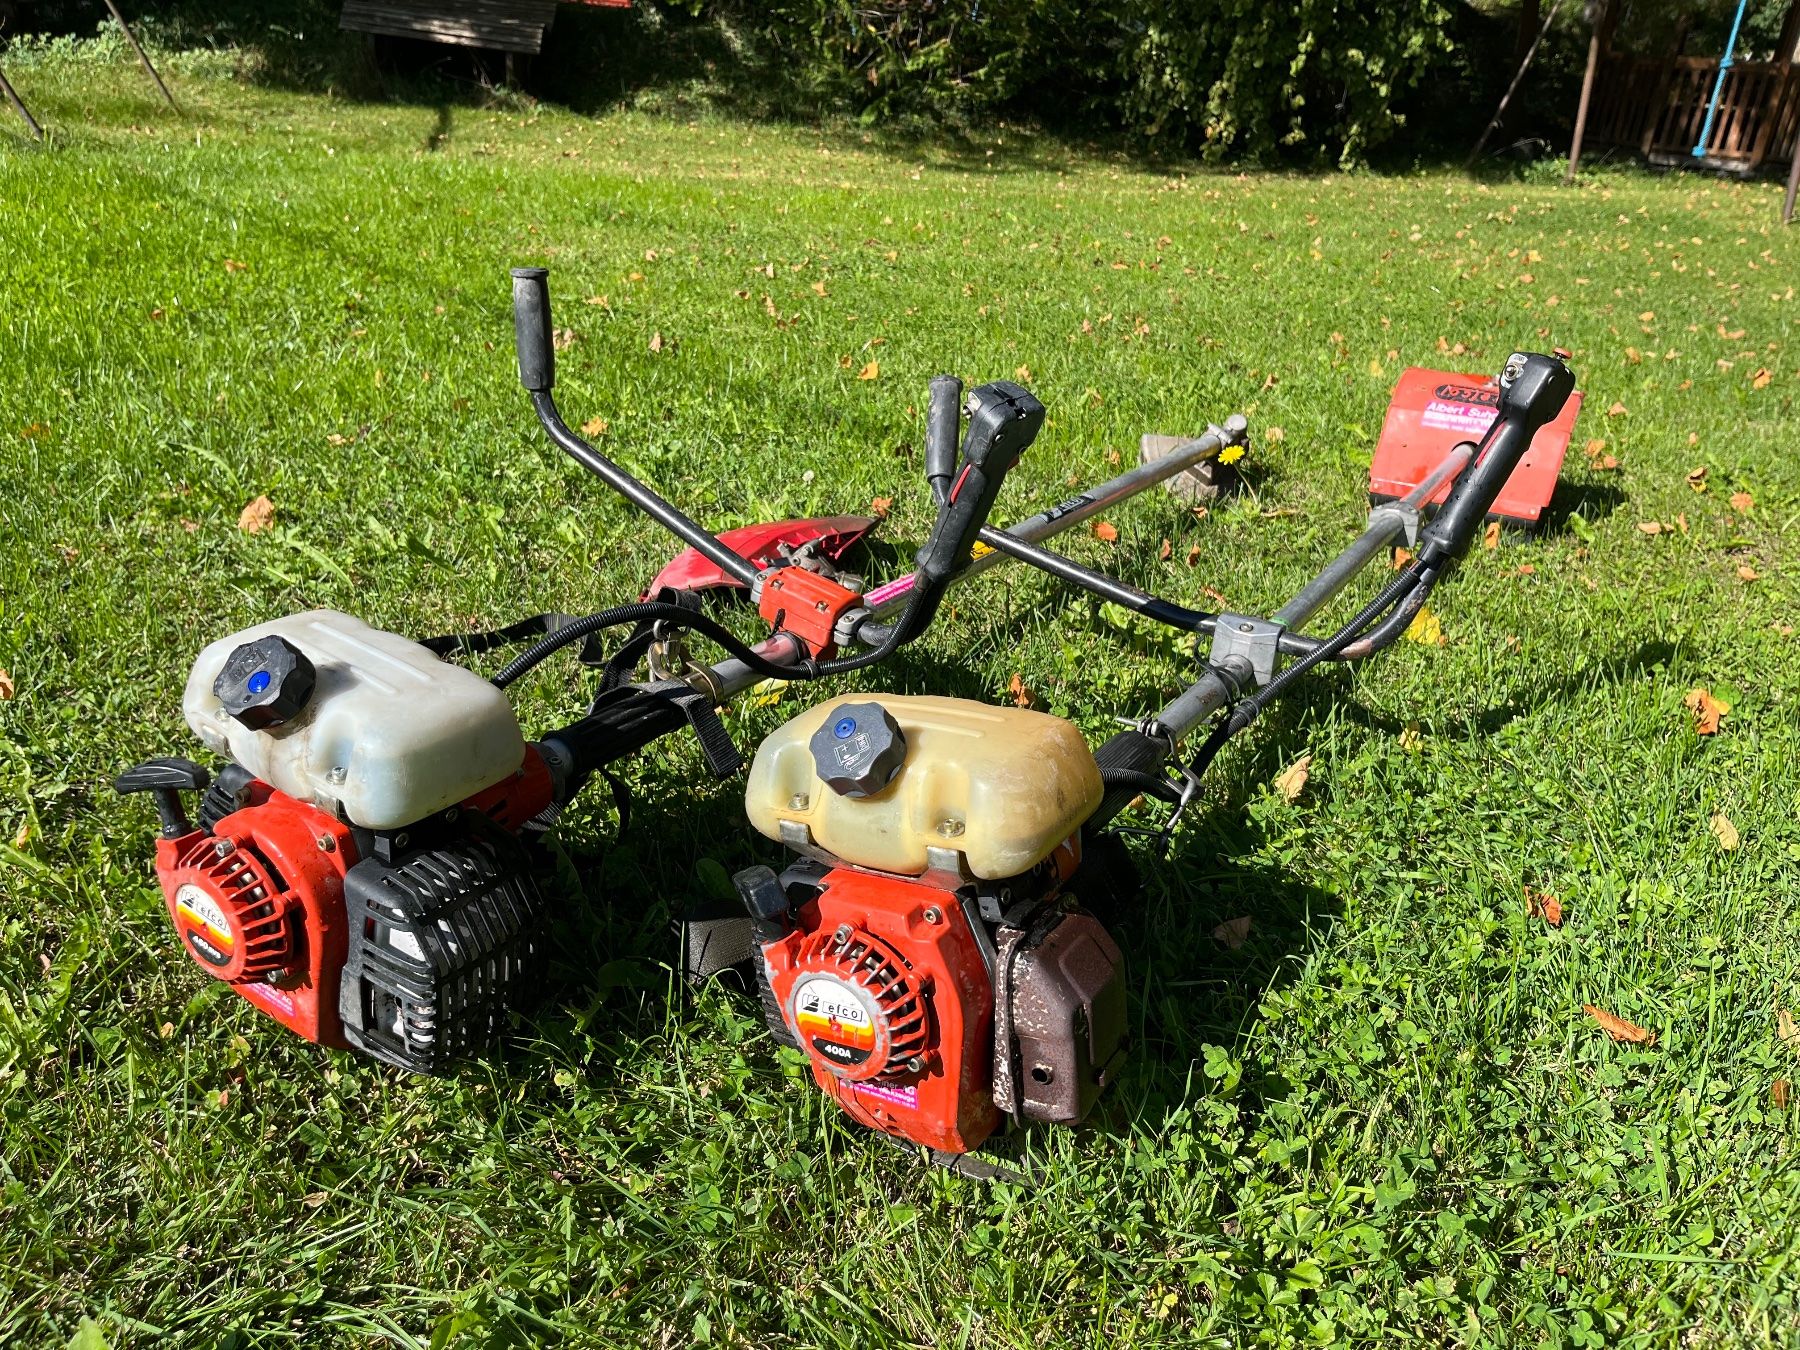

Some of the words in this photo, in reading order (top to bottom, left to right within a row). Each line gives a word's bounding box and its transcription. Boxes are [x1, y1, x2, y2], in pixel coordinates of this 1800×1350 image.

[1427, 402, 1464, 415] Albert
[828, 1004, 858, 1018] efco
[825, 1044, 851, 1059] 400A
